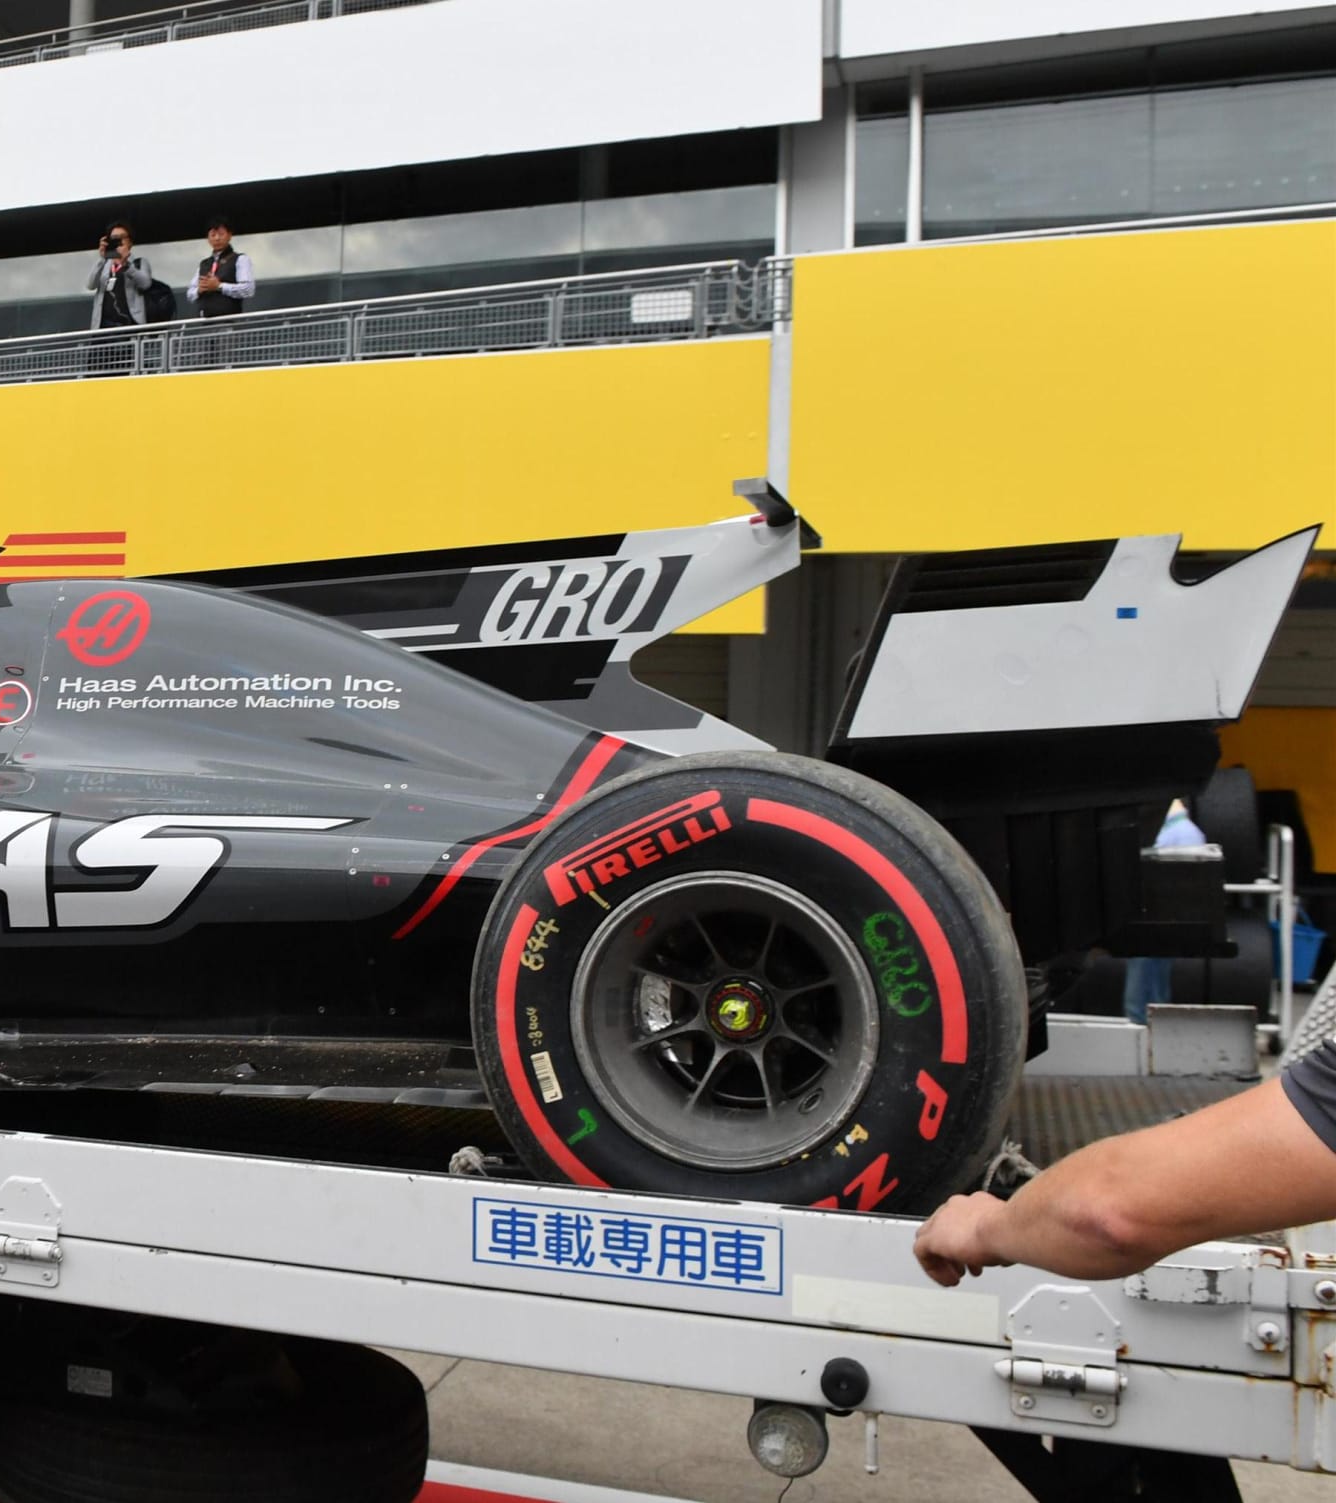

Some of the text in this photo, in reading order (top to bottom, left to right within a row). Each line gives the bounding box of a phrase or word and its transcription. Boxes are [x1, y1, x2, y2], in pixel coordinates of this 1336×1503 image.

[479, 557, 663, 642] GRO
[56, 695, 401, 712] High Performance Machine Tools
[59, 674, 403, 694] Haas Automation Inc.
[543, 789, 733, 907] PIRELLI
[520, 918, 560, 972] 844
[916, 1068, 950, 1142] P
[488, 1207, 767, 1285] 車載専用車
